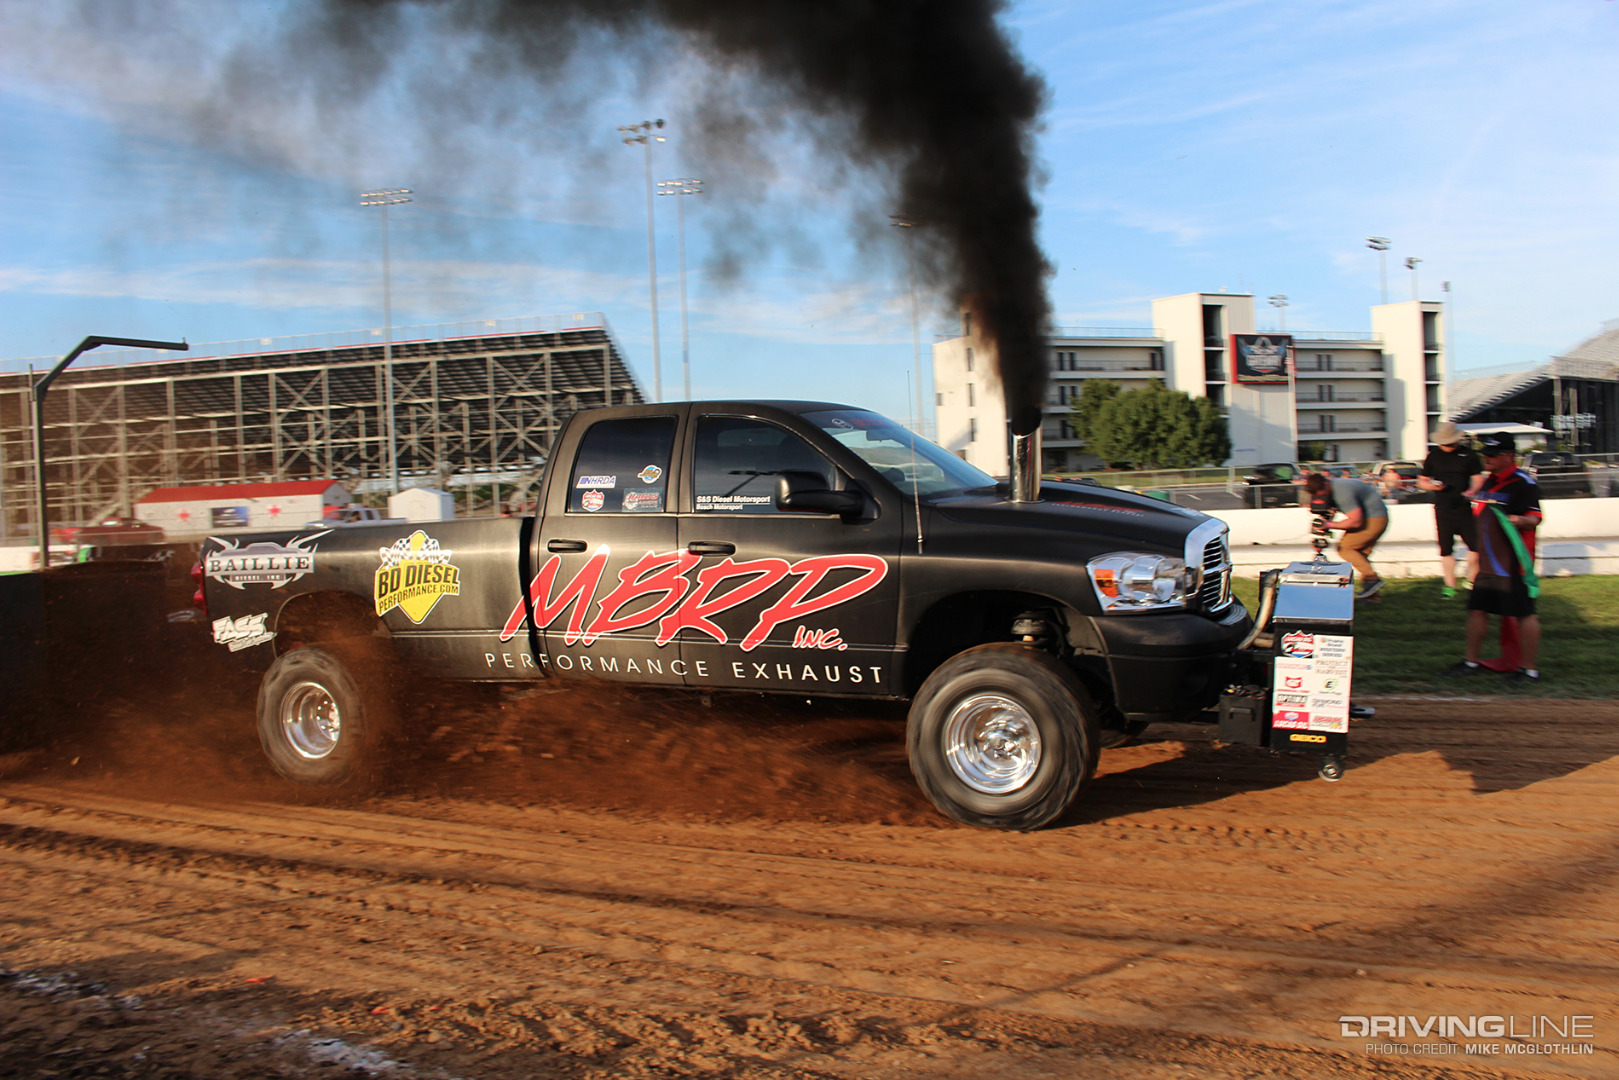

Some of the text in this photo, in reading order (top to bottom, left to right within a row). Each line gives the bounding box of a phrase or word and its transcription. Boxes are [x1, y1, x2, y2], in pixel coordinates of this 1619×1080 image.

[580, 477, 616, 485] NHRDA
[696, 495, 771, 504] S&S Diesel Motorsport
[209, 556, 309, 573] BAILLIE
[378, 564, 459, 599] BD DIESEL
[378, 584, 459, 615] PERFORMANCE.COM
[498, 544, 889, 653] MBRP
[212, 612, 267, 643] FASS
[791, 625, 849, 651] INC.
[485, 652, 882, 685] PERFORMANCE EXHAUST
